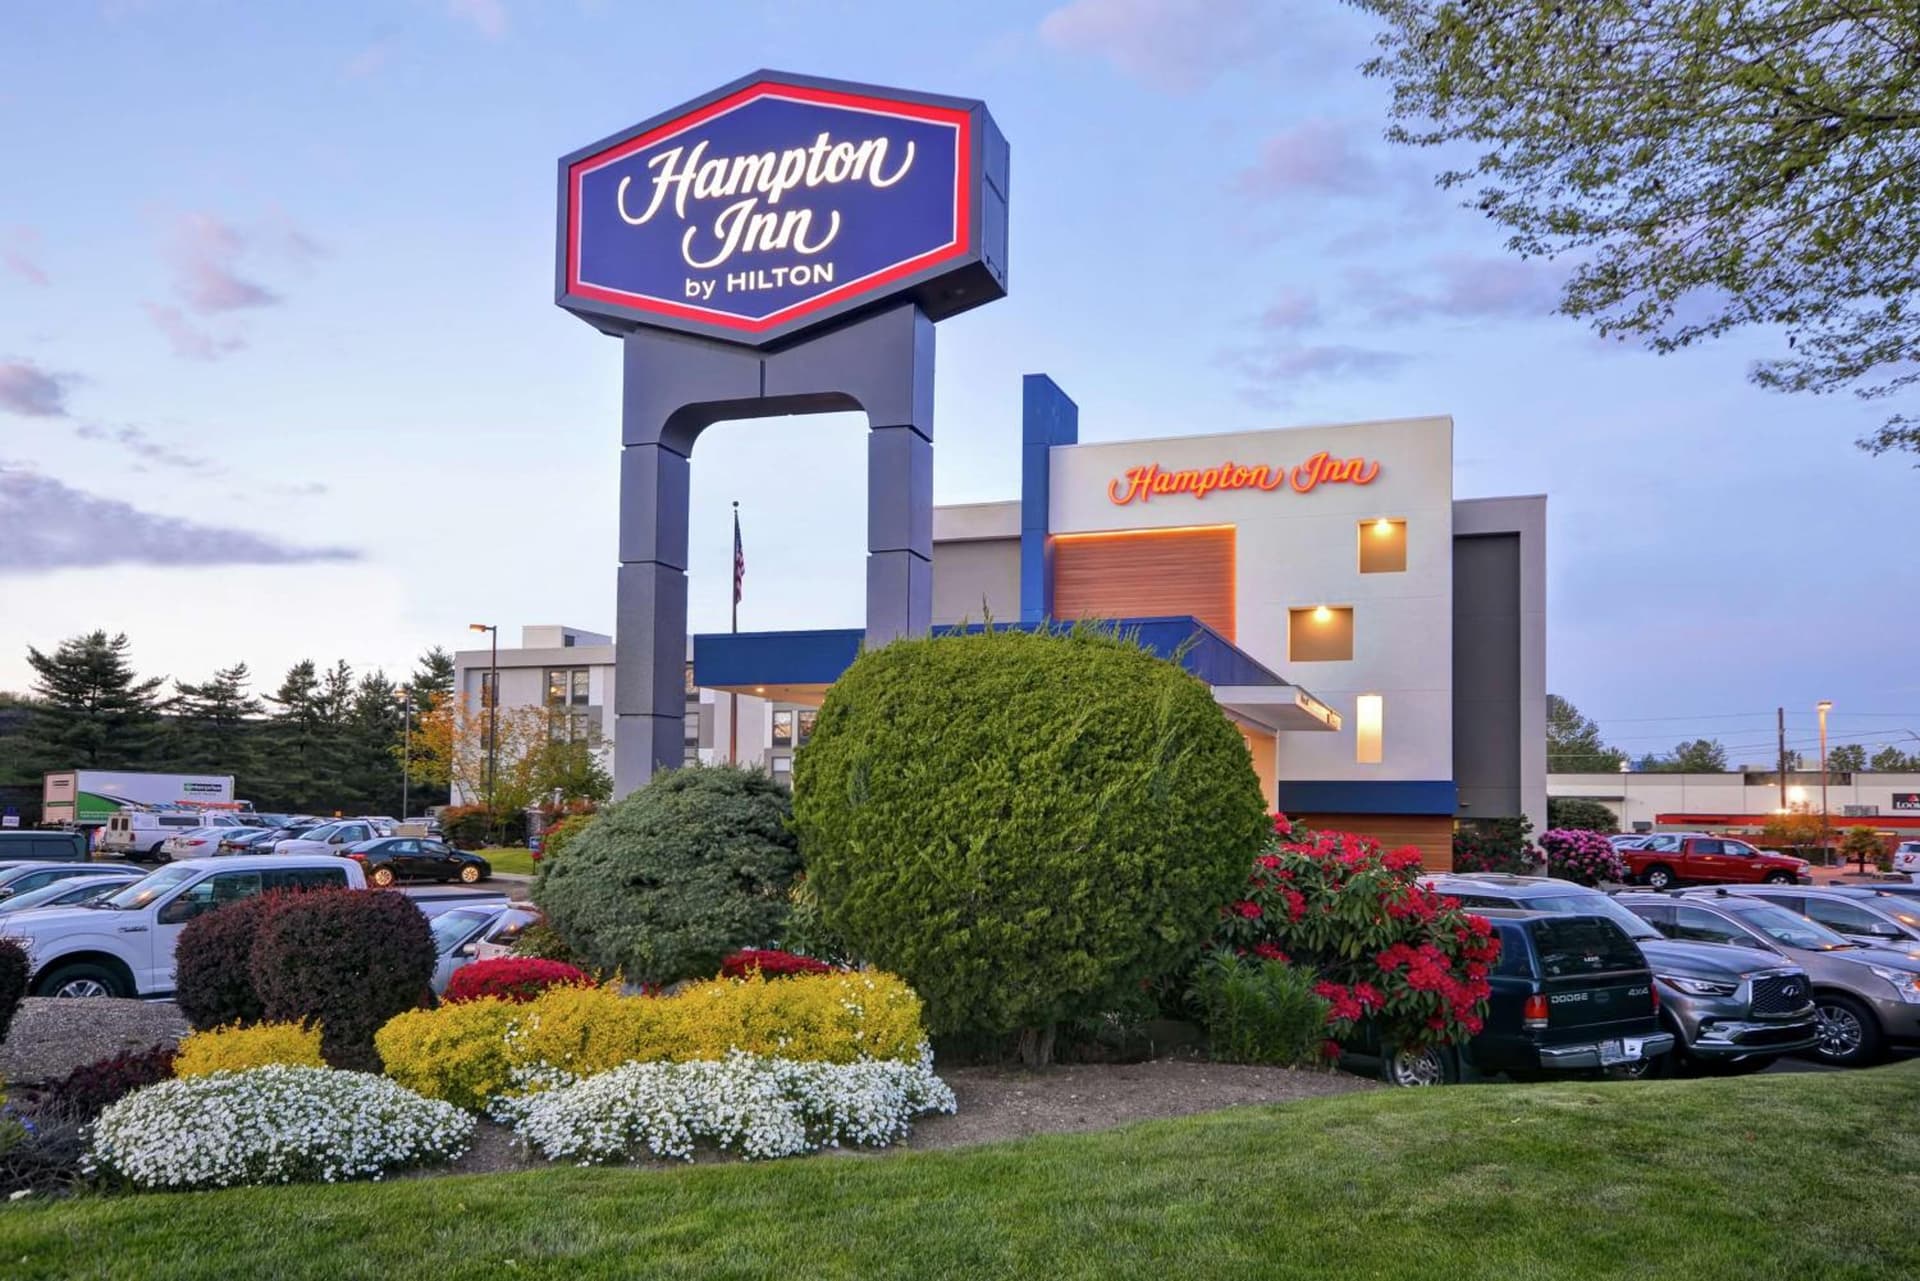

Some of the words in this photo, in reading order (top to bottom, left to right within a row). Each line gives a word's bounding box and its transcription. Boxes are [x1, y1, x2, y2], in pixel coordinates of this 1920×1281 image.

[617, 131, 915, 225] Hampton
[681, 197, 841, 269] Inn
[685, 278, 716, 300] by
[727, 262, 834, 293] HILTON
[1107, 461, 1284, 505] Hampton
[1289, 451, 1380, 494] Inn
[1551, 992, 1589, 1004] DODGE
